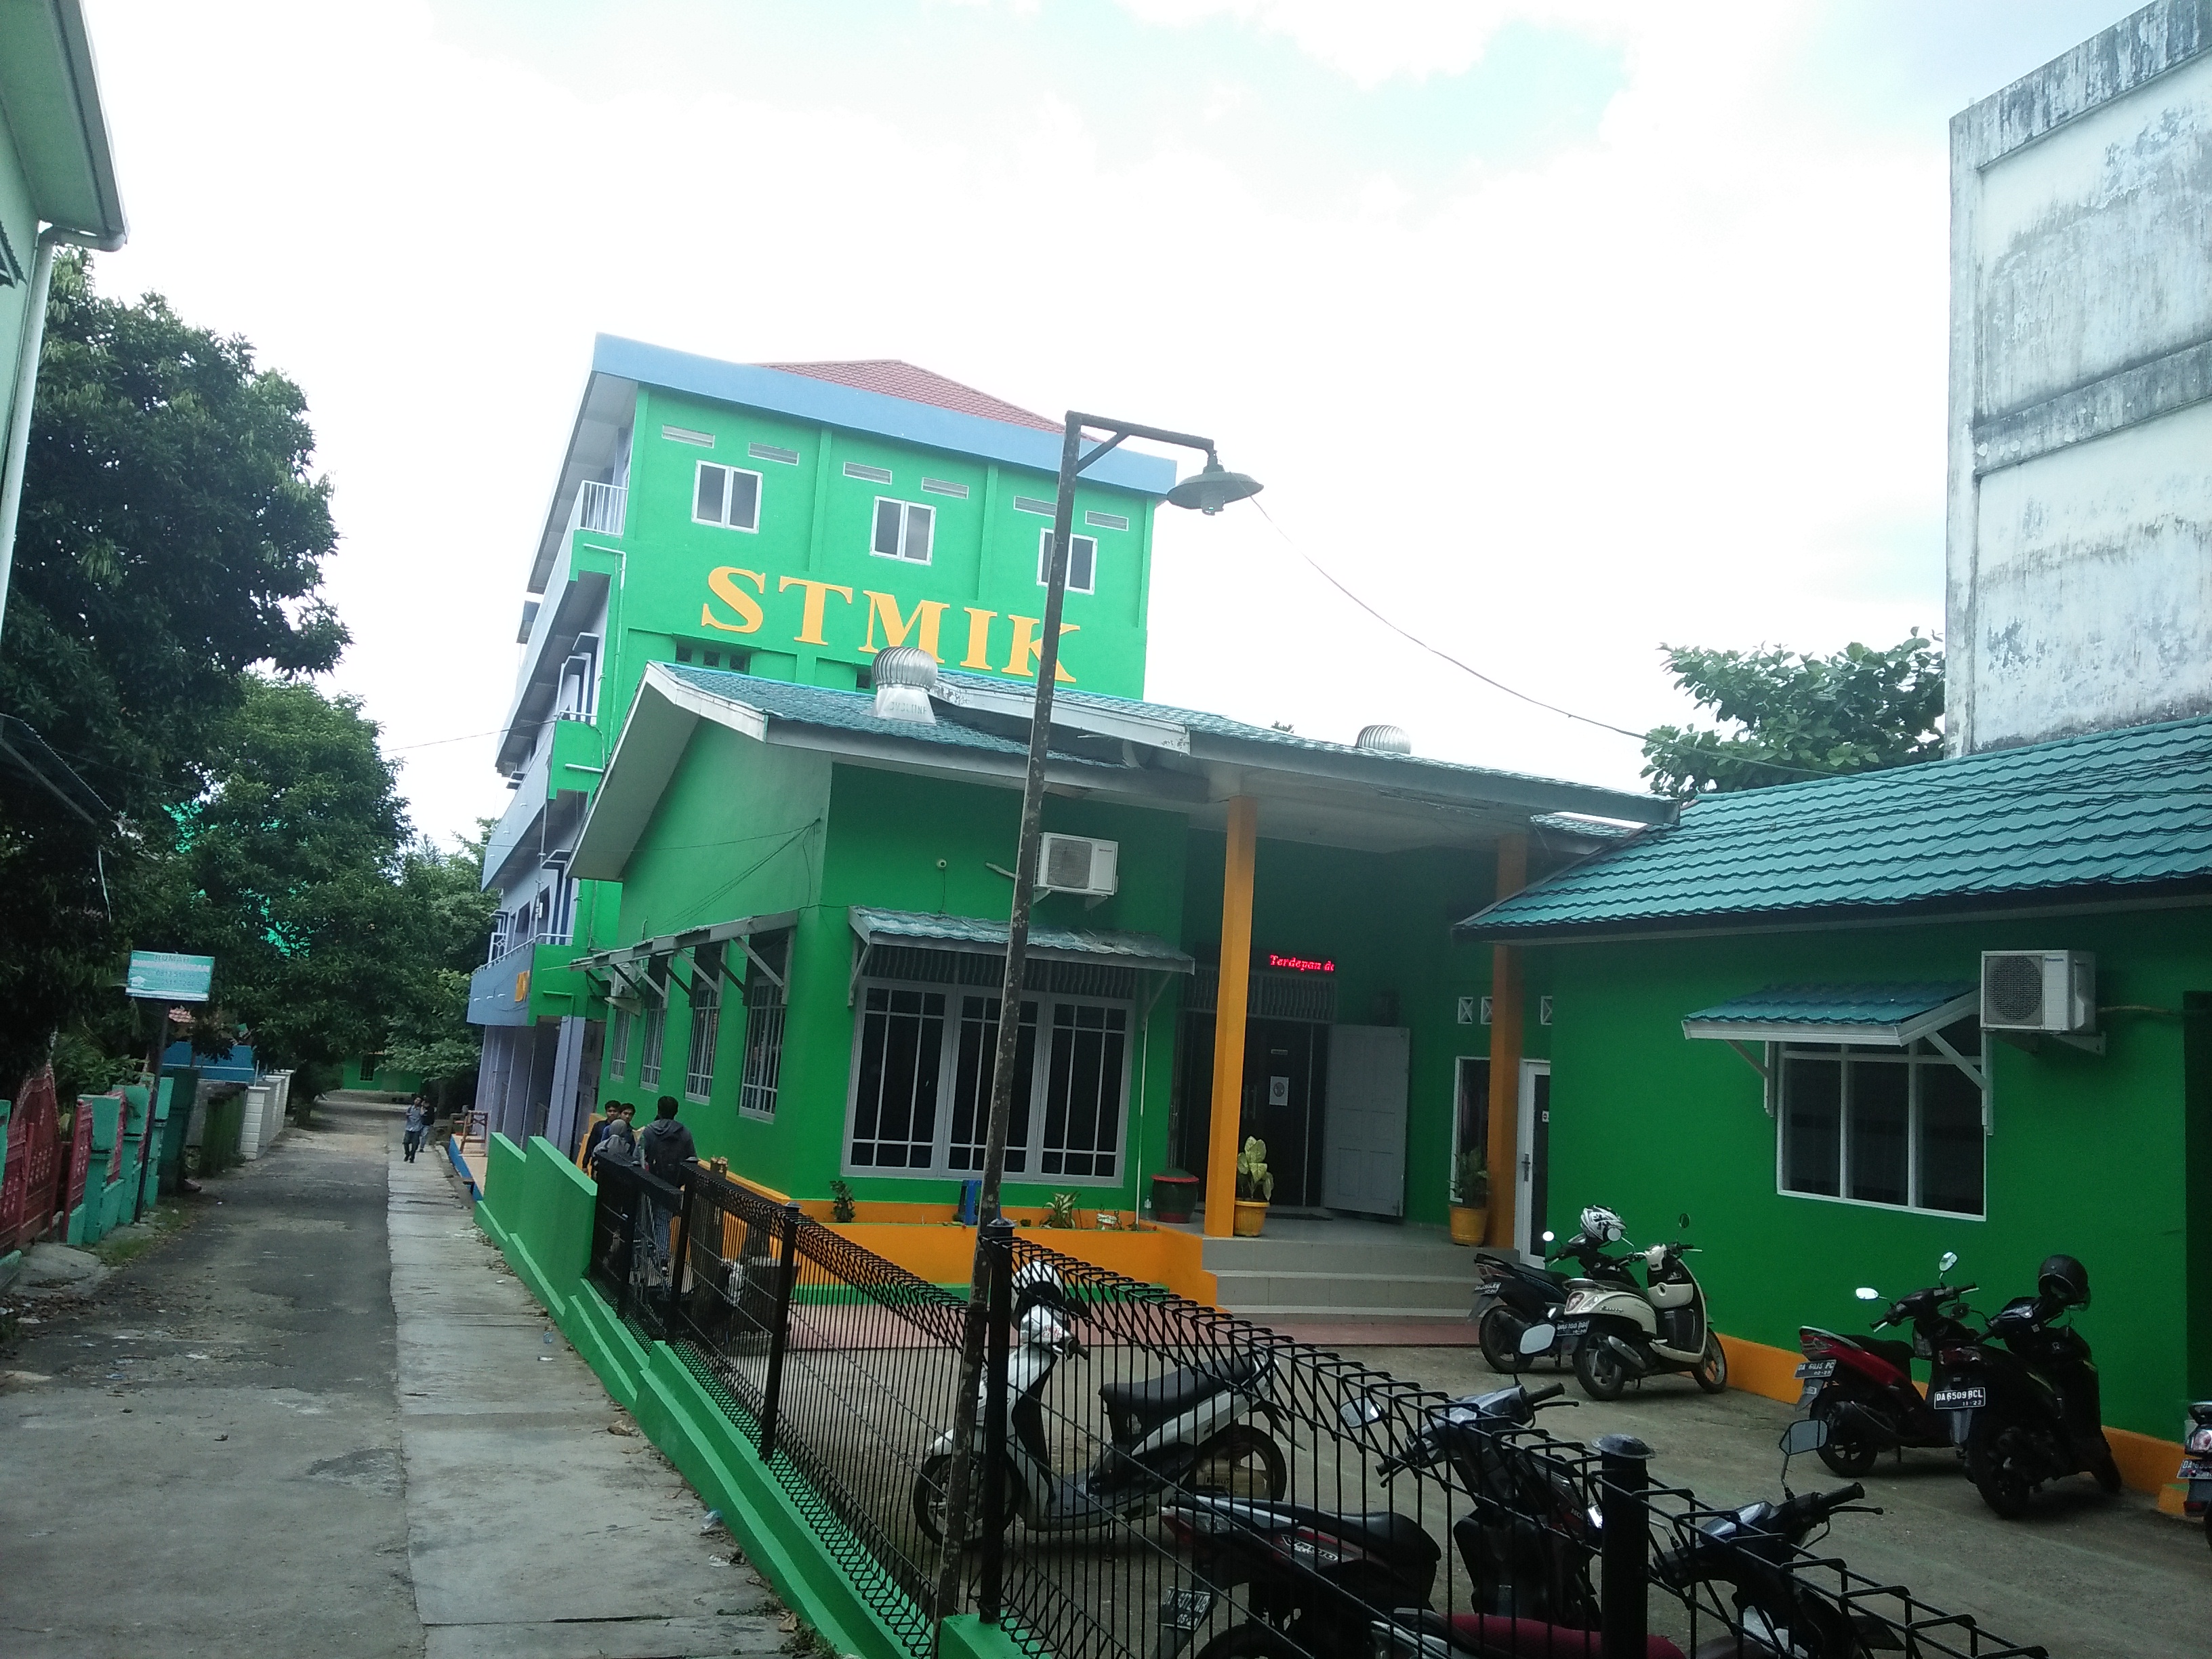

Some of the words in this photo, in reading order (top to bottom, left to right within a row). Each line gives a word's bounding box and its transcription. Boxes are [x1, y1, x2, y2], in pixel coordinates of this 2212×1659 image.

[701, 566, 1080, 683] STMIK
[1270, 954, 1322, 972] Terdepan
[1936, 1393, 1946, 1401] DA
[1946, 1391, 1967, 1401] 6509
